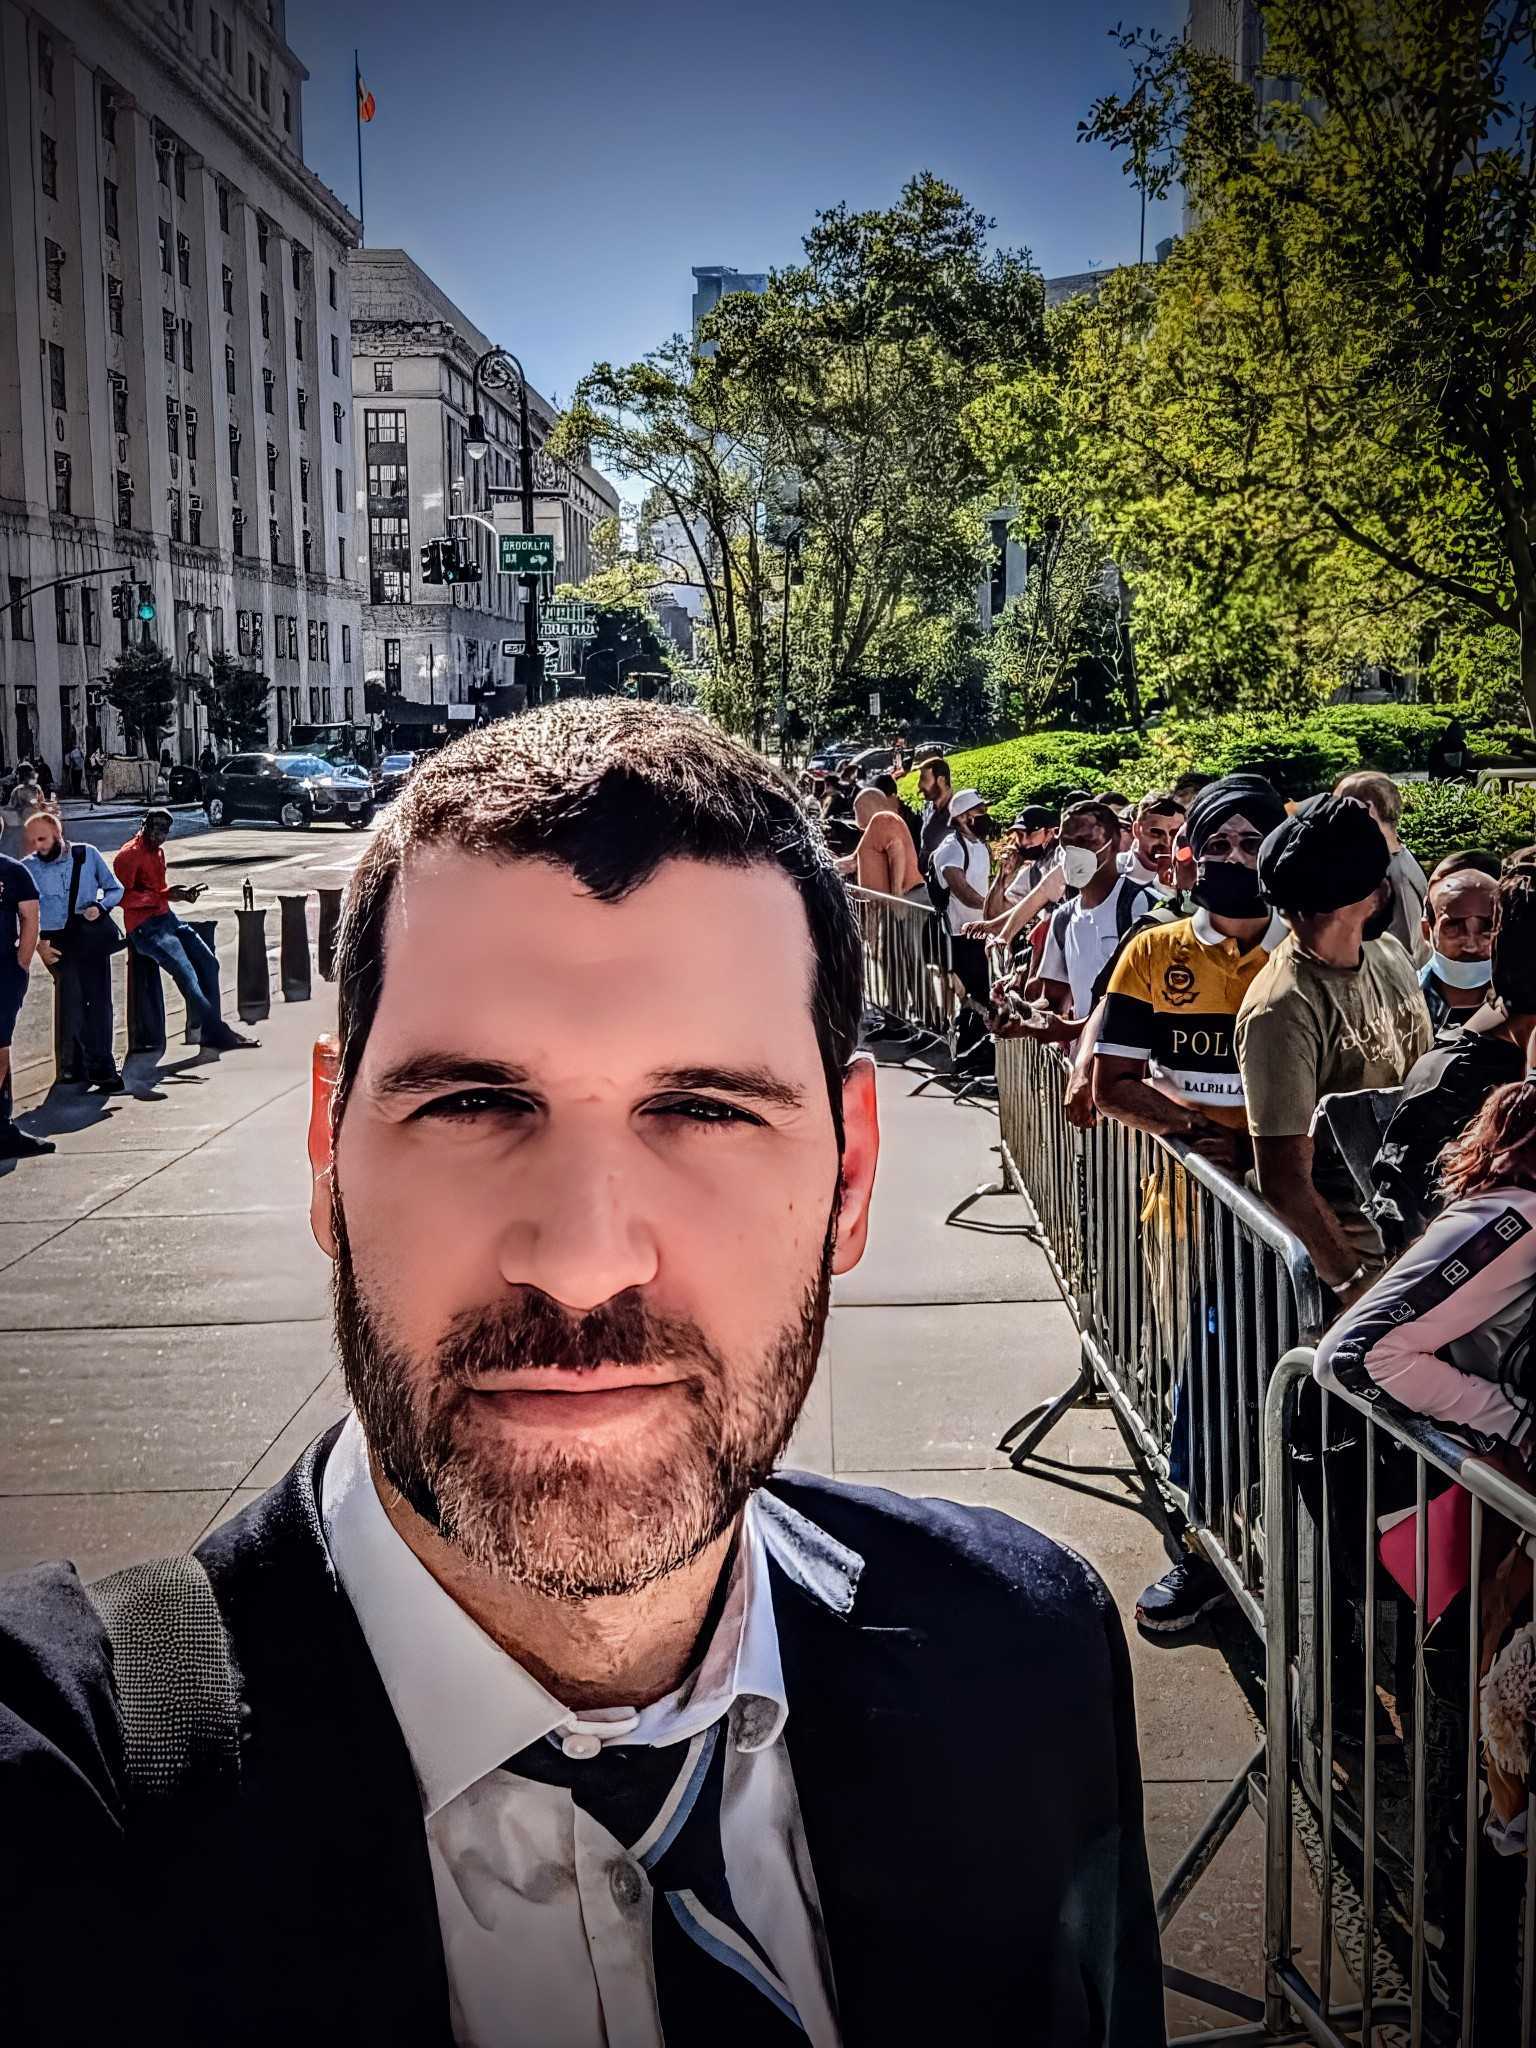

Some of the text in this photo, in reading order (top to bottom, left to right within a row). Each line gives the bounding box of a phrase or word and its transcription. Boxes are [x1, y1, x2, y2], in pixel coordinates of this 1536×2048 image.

[503, 541, 550, 551] BROOKLYN
[1172, 1029, 1228, 1056] POL
[1184, 1080, 1245, 1095] RALPH LA
